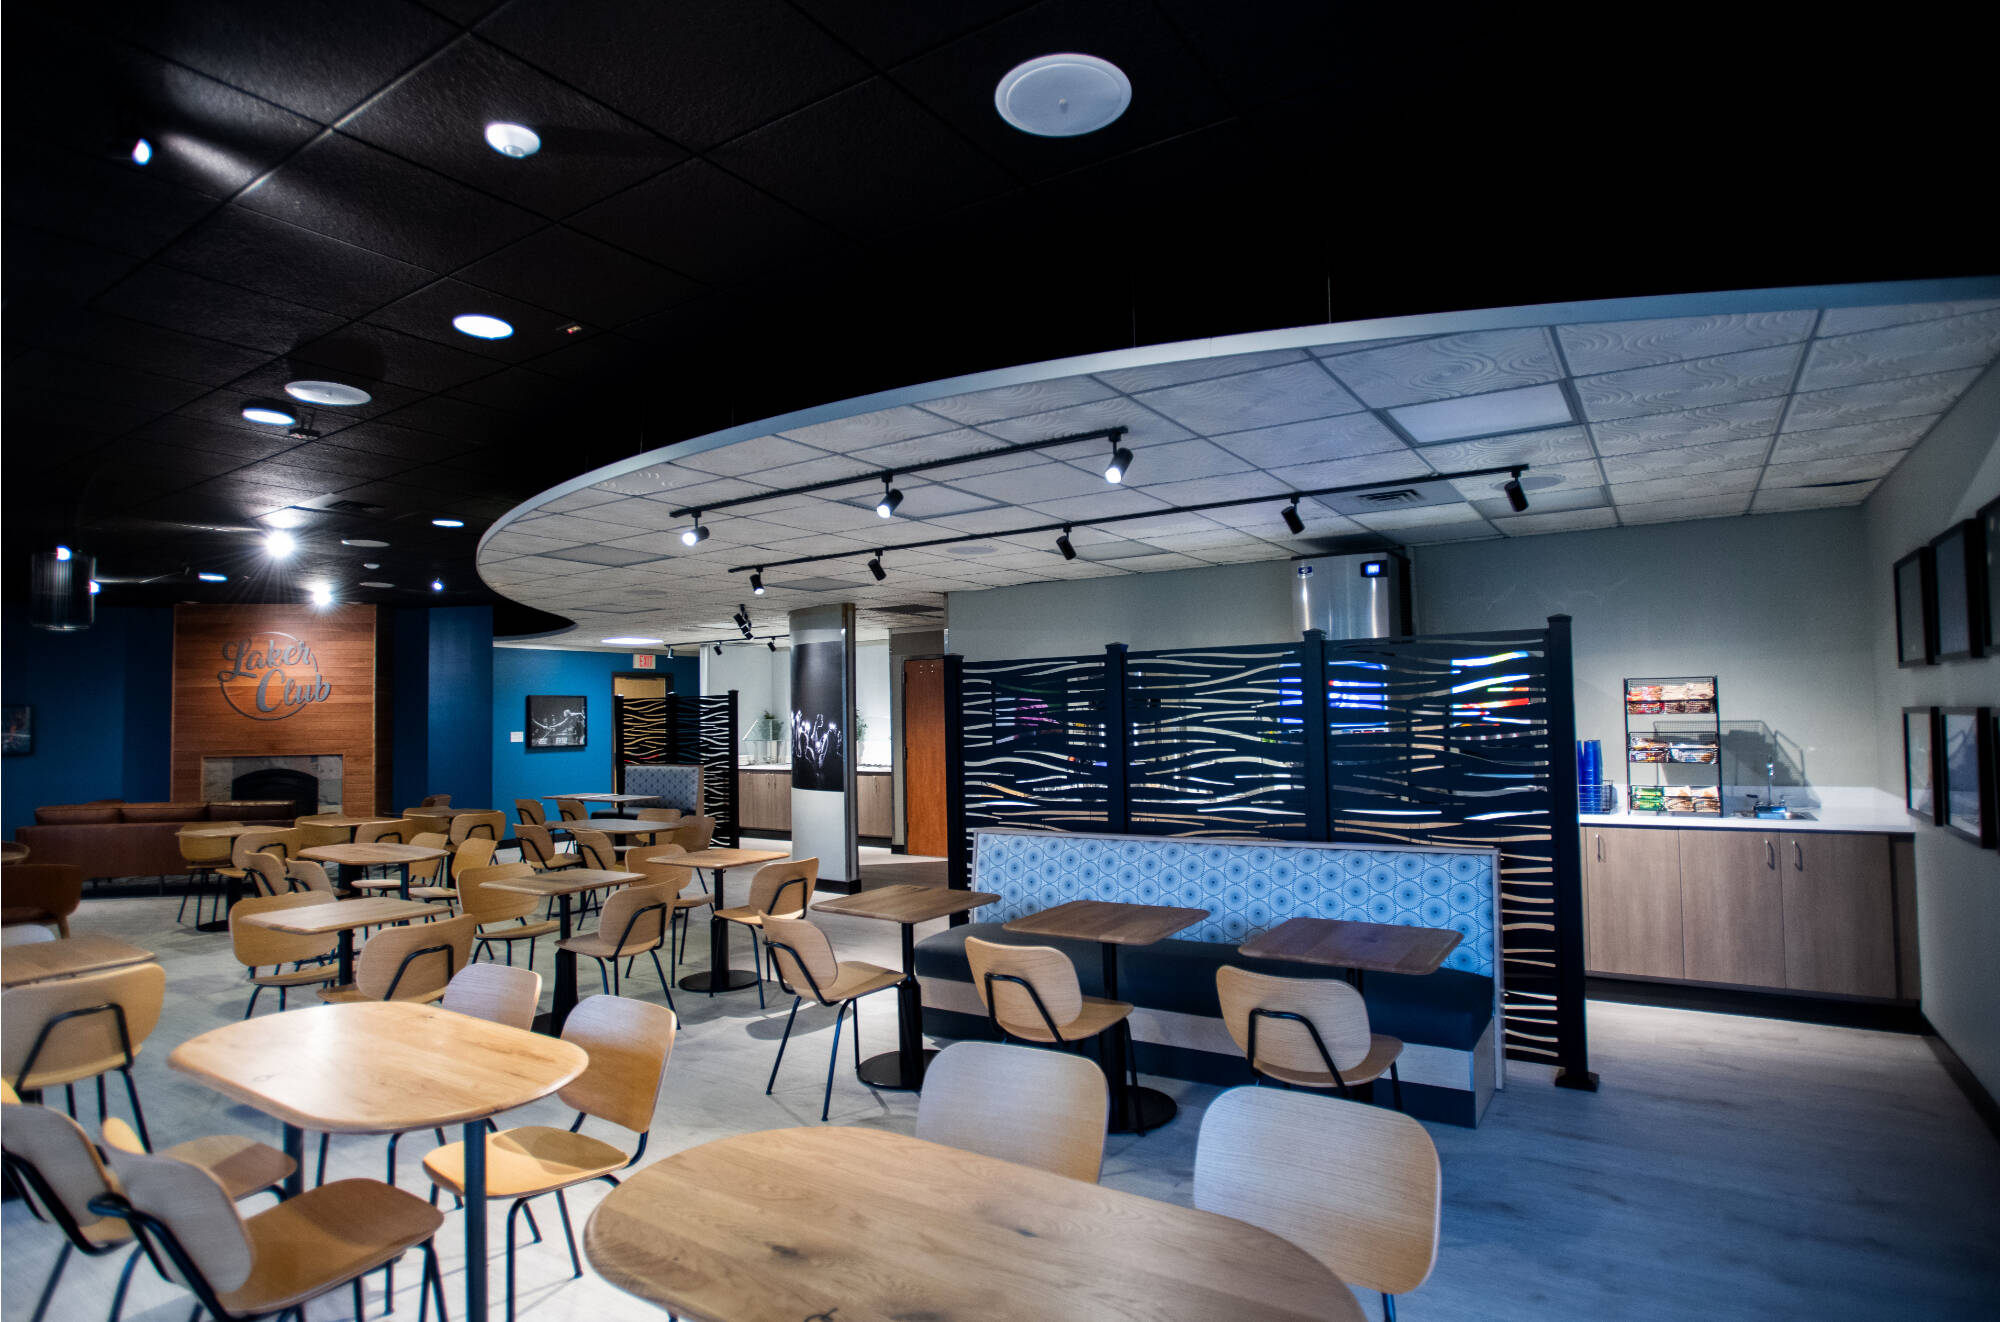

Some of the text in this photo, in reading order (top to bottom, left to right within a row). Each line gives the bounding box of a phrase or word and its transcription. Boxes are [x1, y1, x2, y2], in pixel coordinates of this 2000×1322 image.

[217, 638, 311, 682] Laker
[639, 655, 653, 667] EXIT
[256, 668, 332, 712] Club
